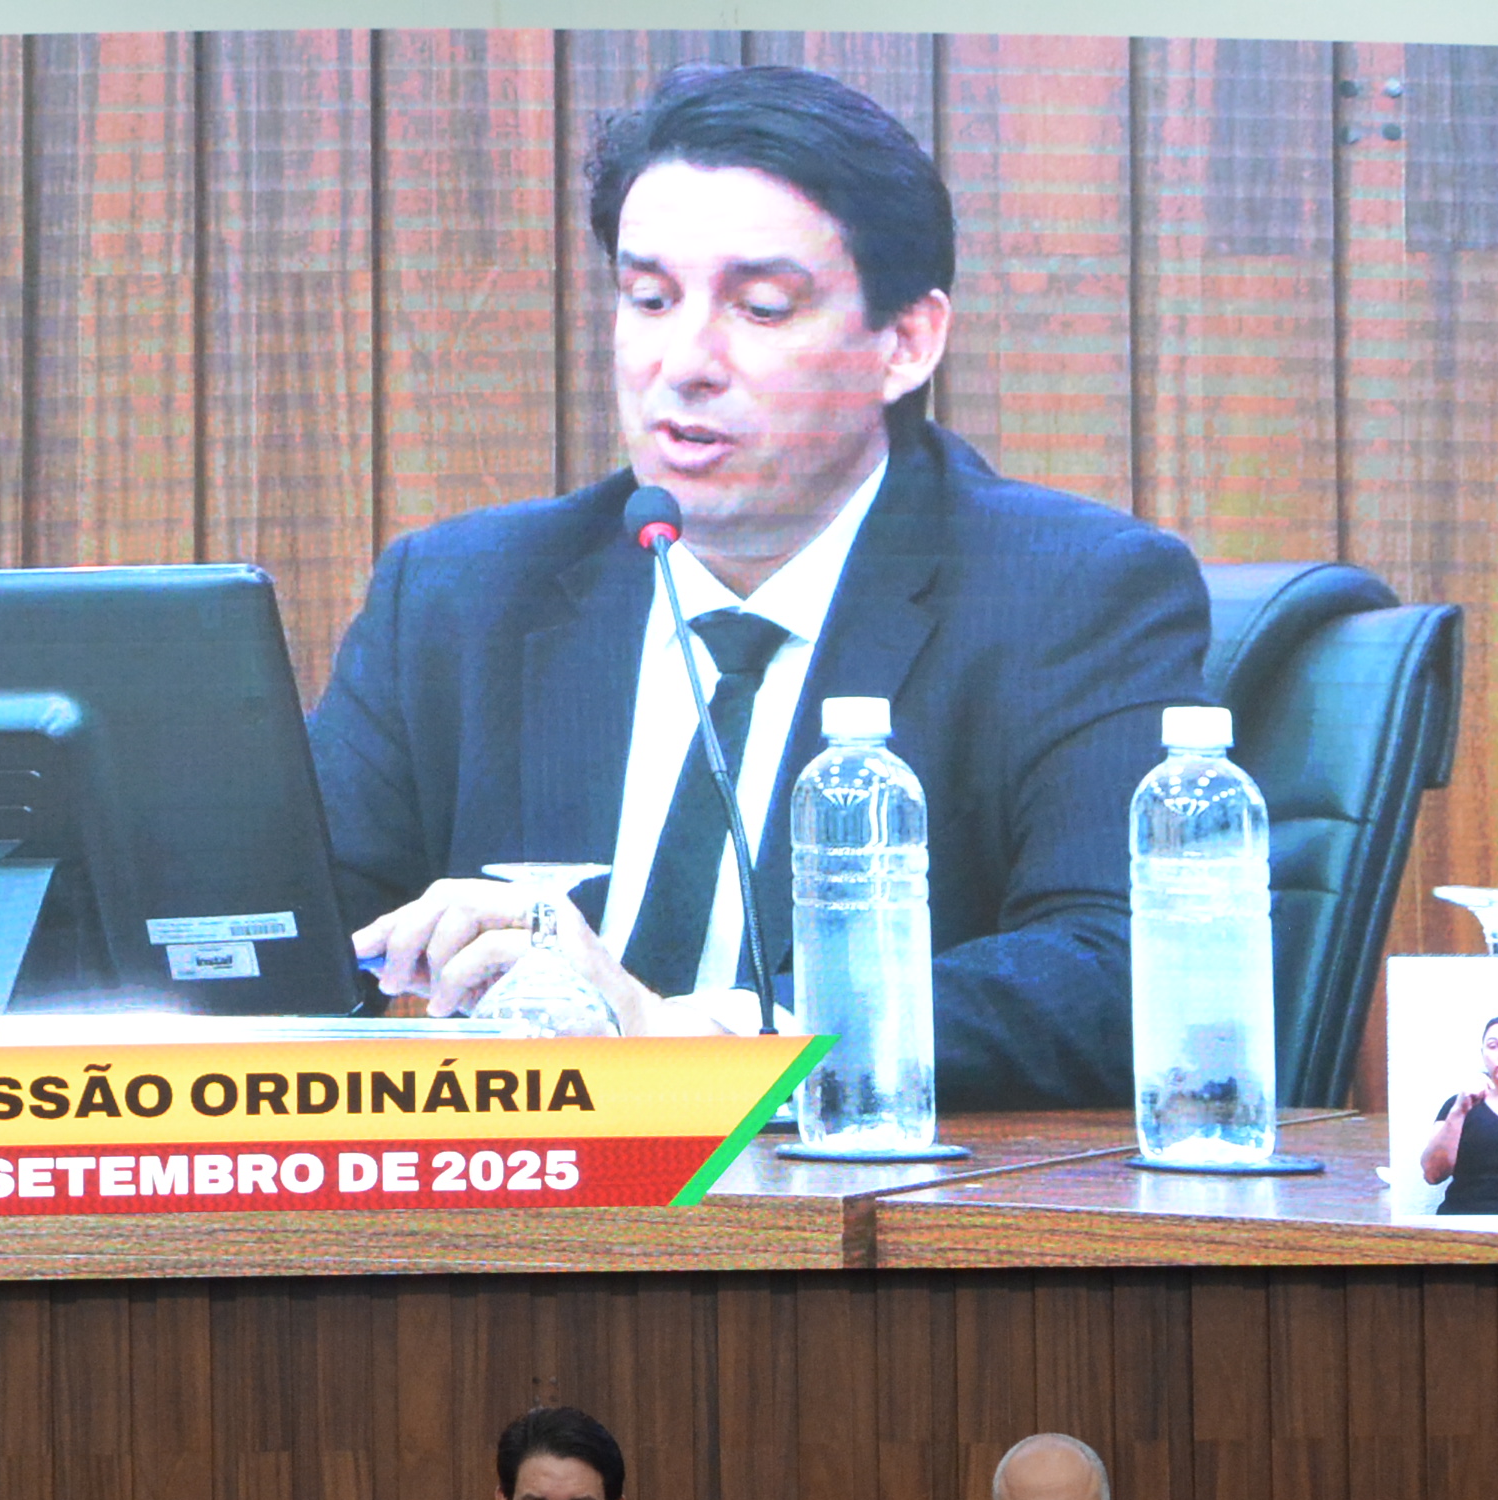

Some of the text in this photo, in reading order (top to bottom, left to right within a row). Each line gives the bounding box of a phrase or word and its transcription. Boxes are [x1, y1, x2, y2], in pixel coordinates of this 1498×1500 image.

[191, 1056, 594, 1116] ORDINÁRIA
[338, 1151, 420, 1193] DE
[431, 1150, 579, 1191] 2025
